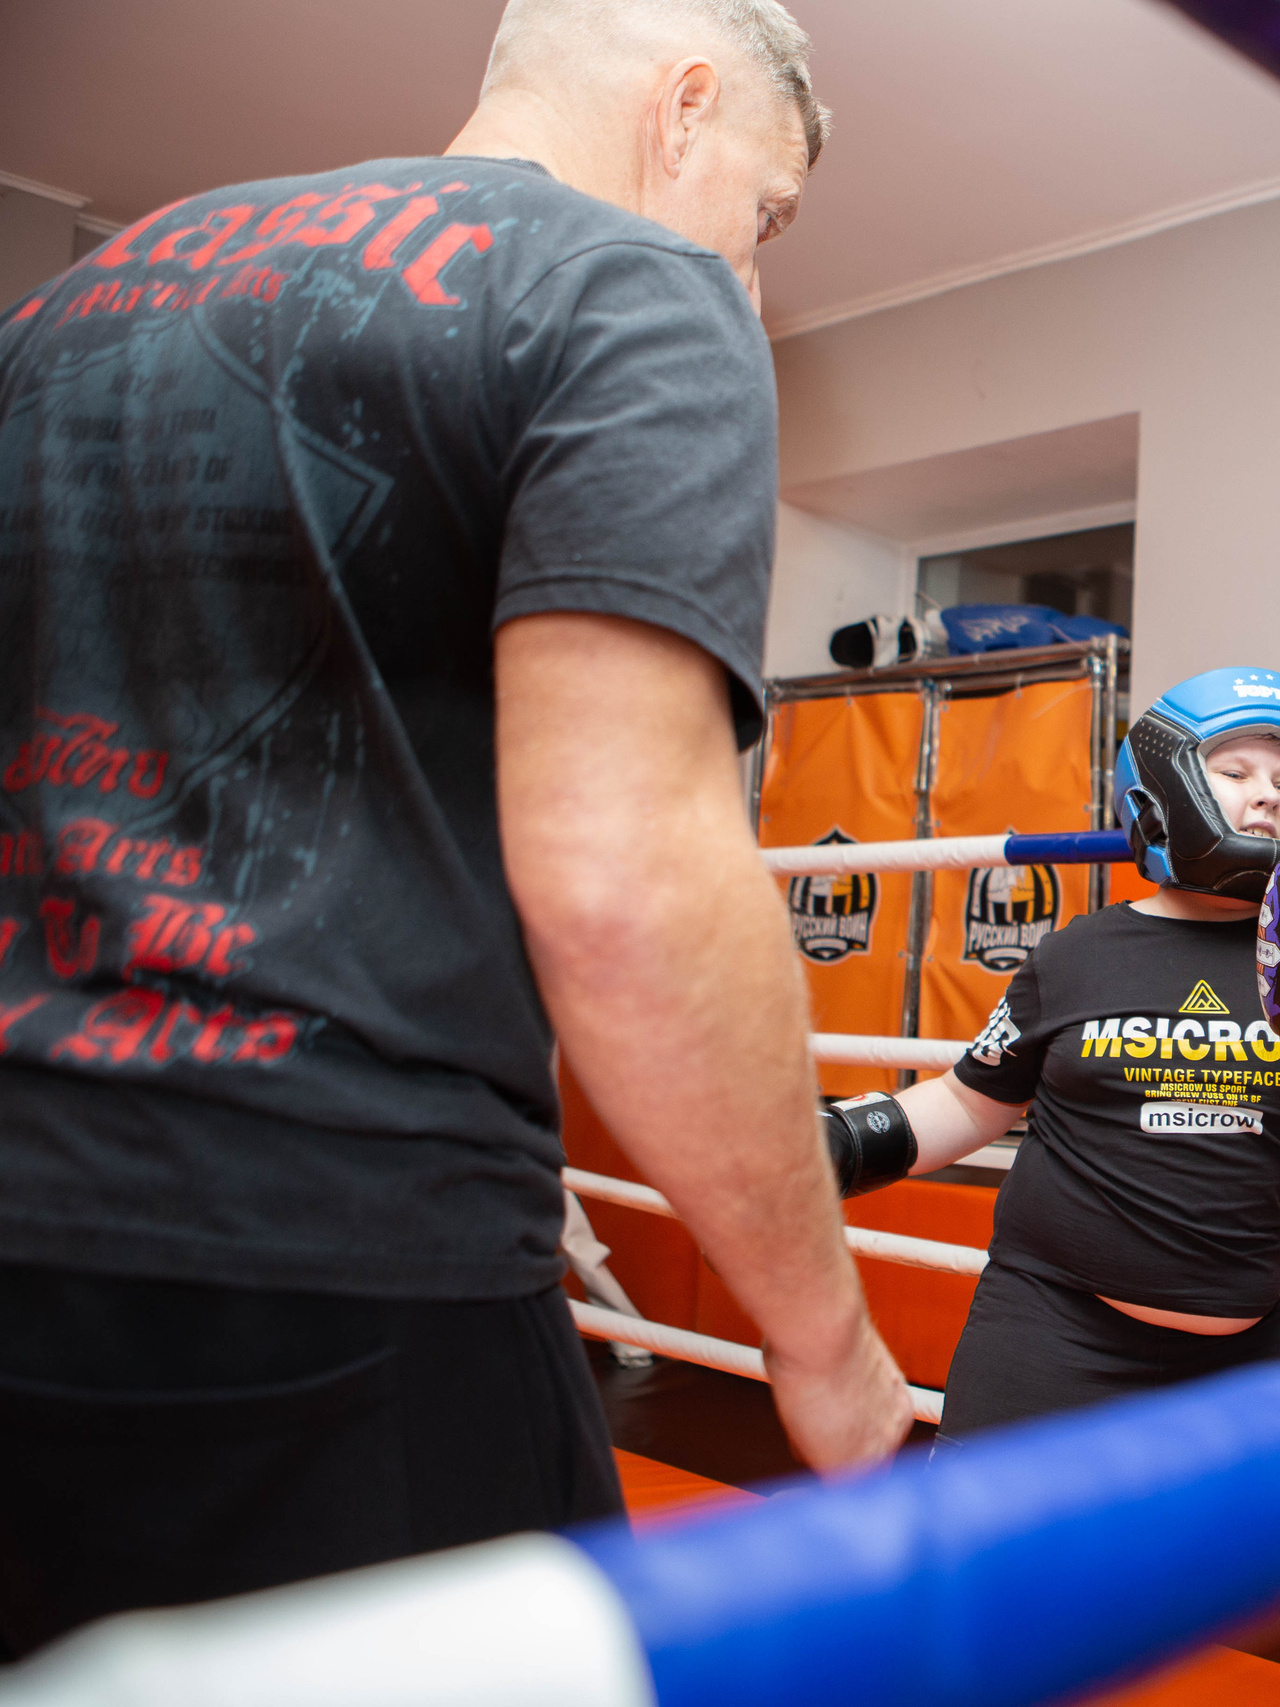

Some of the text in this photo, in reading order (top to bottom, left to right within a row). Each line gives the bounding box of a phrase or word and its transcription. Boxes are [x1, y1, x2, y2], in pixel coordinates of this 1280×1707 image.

[968, 920, 1019, 952] РУССКИЙ
[1124, 1067, 1195, 1083] VINTAGE
[1145, 1090, 1172, 1098] BRING
[1160, 1083, 1247, 1094] MSICROW US SPORT
[1149, 1107, 1255, 1128] msicrow
